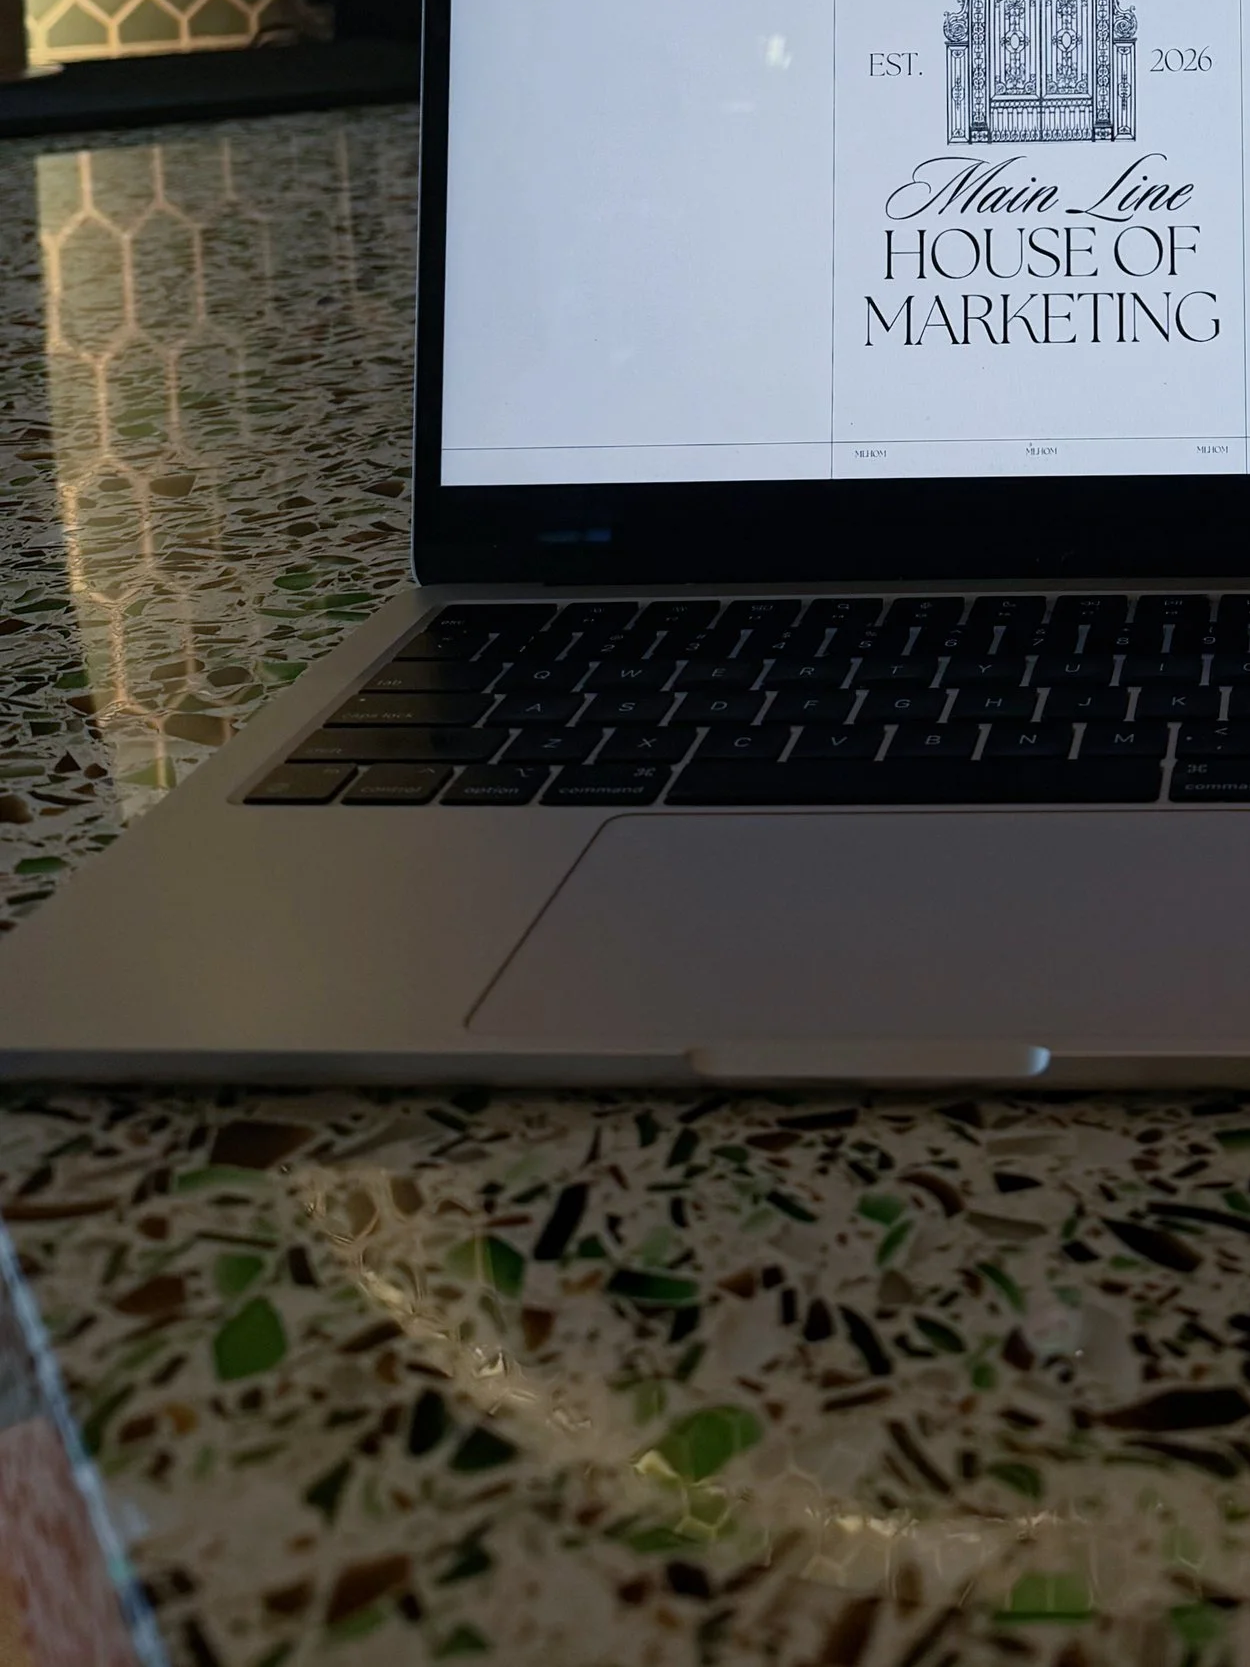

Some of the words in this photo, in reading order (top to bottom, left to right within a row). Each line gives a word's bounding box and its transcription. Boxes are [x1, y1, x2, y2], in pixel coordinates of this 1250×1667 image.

[1149, 45, 1213, 73] 2026
[869, 52, 923, 77] EST.
[885, 155, 1059, 220] Main
[1065, 153, 1194, 223] Line
[883, 226, 1099, 280] HOUSE
[1113, 225, 1201, 278] OF
[863, 290, 1220, 347] MARKETING
[1116, 637, 1129, 645] 8
[621, 669, 642, 678] W
[711, 668, 725, 677] E
[799, 667, 815, 676] R
[891, 665, 904, 675] T
[979, 664, 992, 674] Y
[1065, 664, 1081, 673] U
[533, 670, 551, 680] Q
[710, 701, 728, 711] D
[803, 700, 818, 709] F
[894, 698, 911, 709] G
[985, 698, 1003, 708] H
[1078, 697, 1092, 707] J
[1171, 696, 1186, 706] K
[525, 703, 541, 712] A
[618, 702, 636, 712] S
[638, 738, 657, 748] X
[733, 737, 752, 748] C
[831, 736, 848, 746] V
[924, 735, 941, 745] B
[1019, 734, 1037, 744] N
[1114, 733, 1135, 743] M
[542, 738, 562, 749] Z
[558, 786, 645, 794] command
